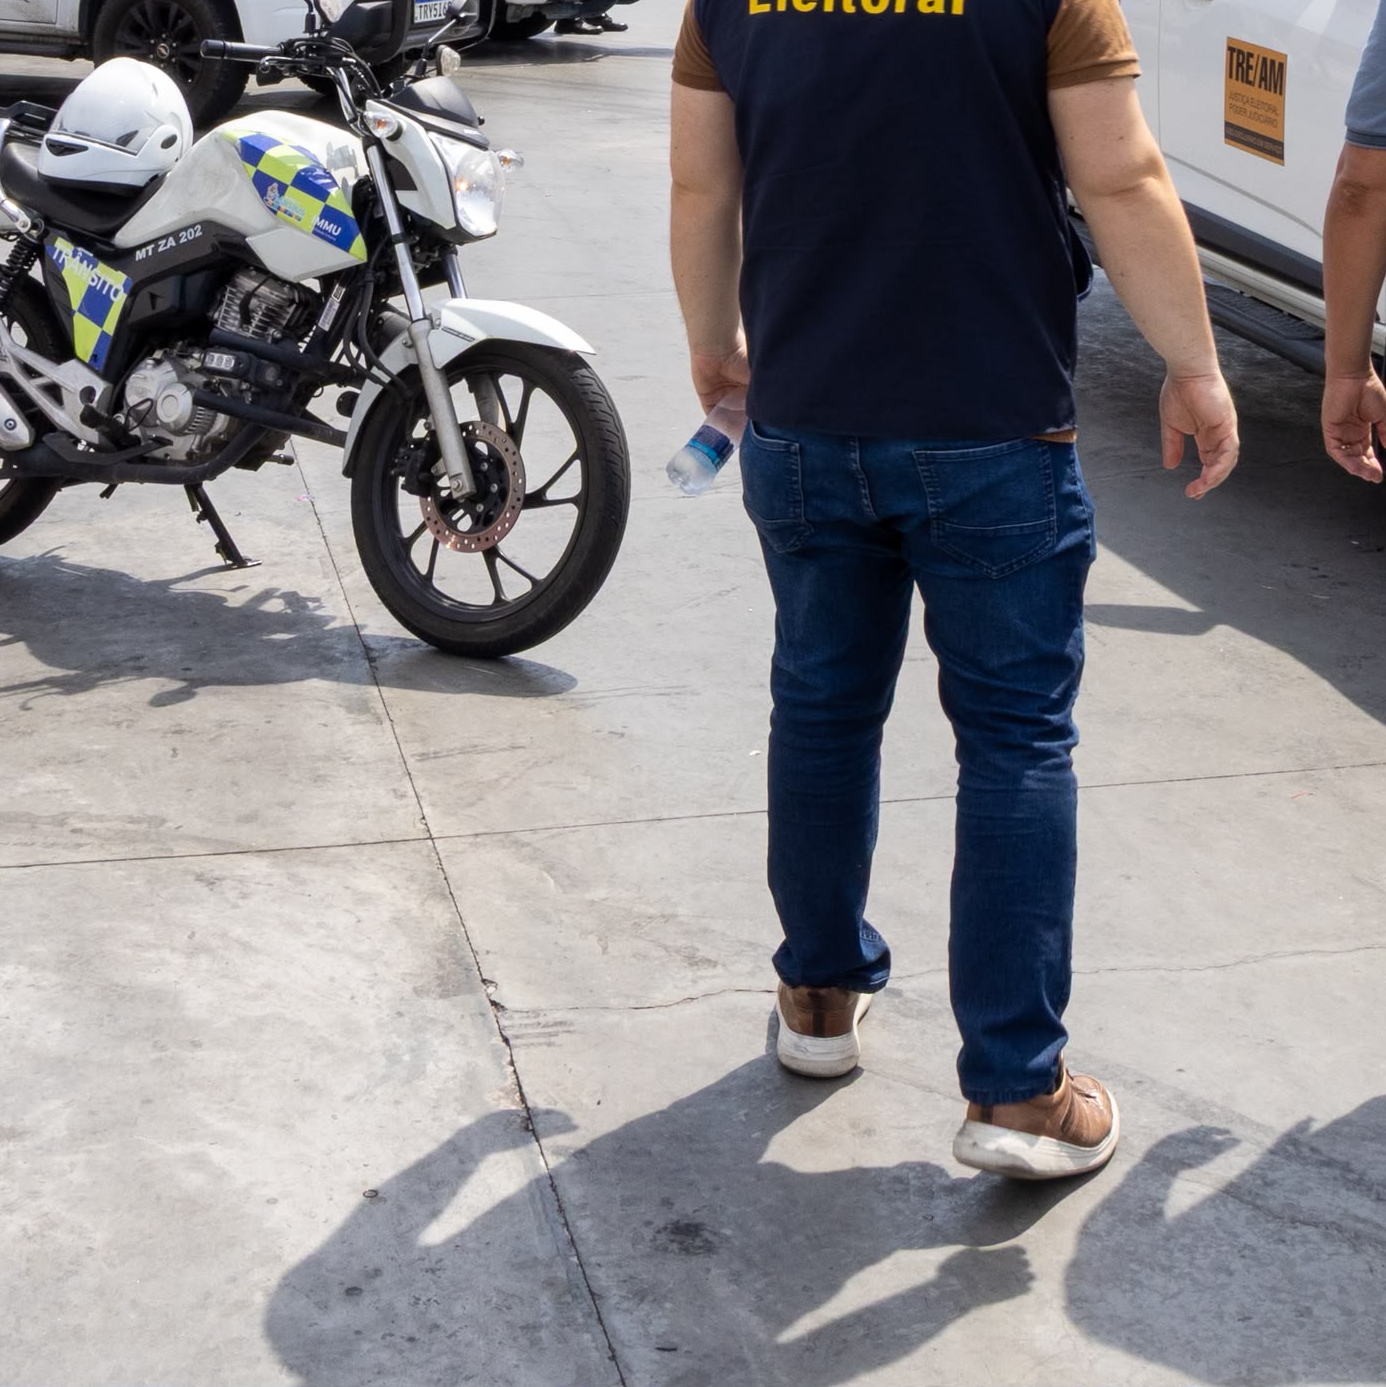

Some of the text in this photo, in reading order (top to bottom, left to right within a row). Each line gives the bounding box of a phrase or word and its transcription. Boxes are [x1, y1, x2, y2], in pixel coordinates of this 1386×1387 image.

[1227, 45, 1284, 96] TRE/AM
[135, 224, 203, 261] MT ZA 202
[52, 243, 124, 302] TRÂNSITO
